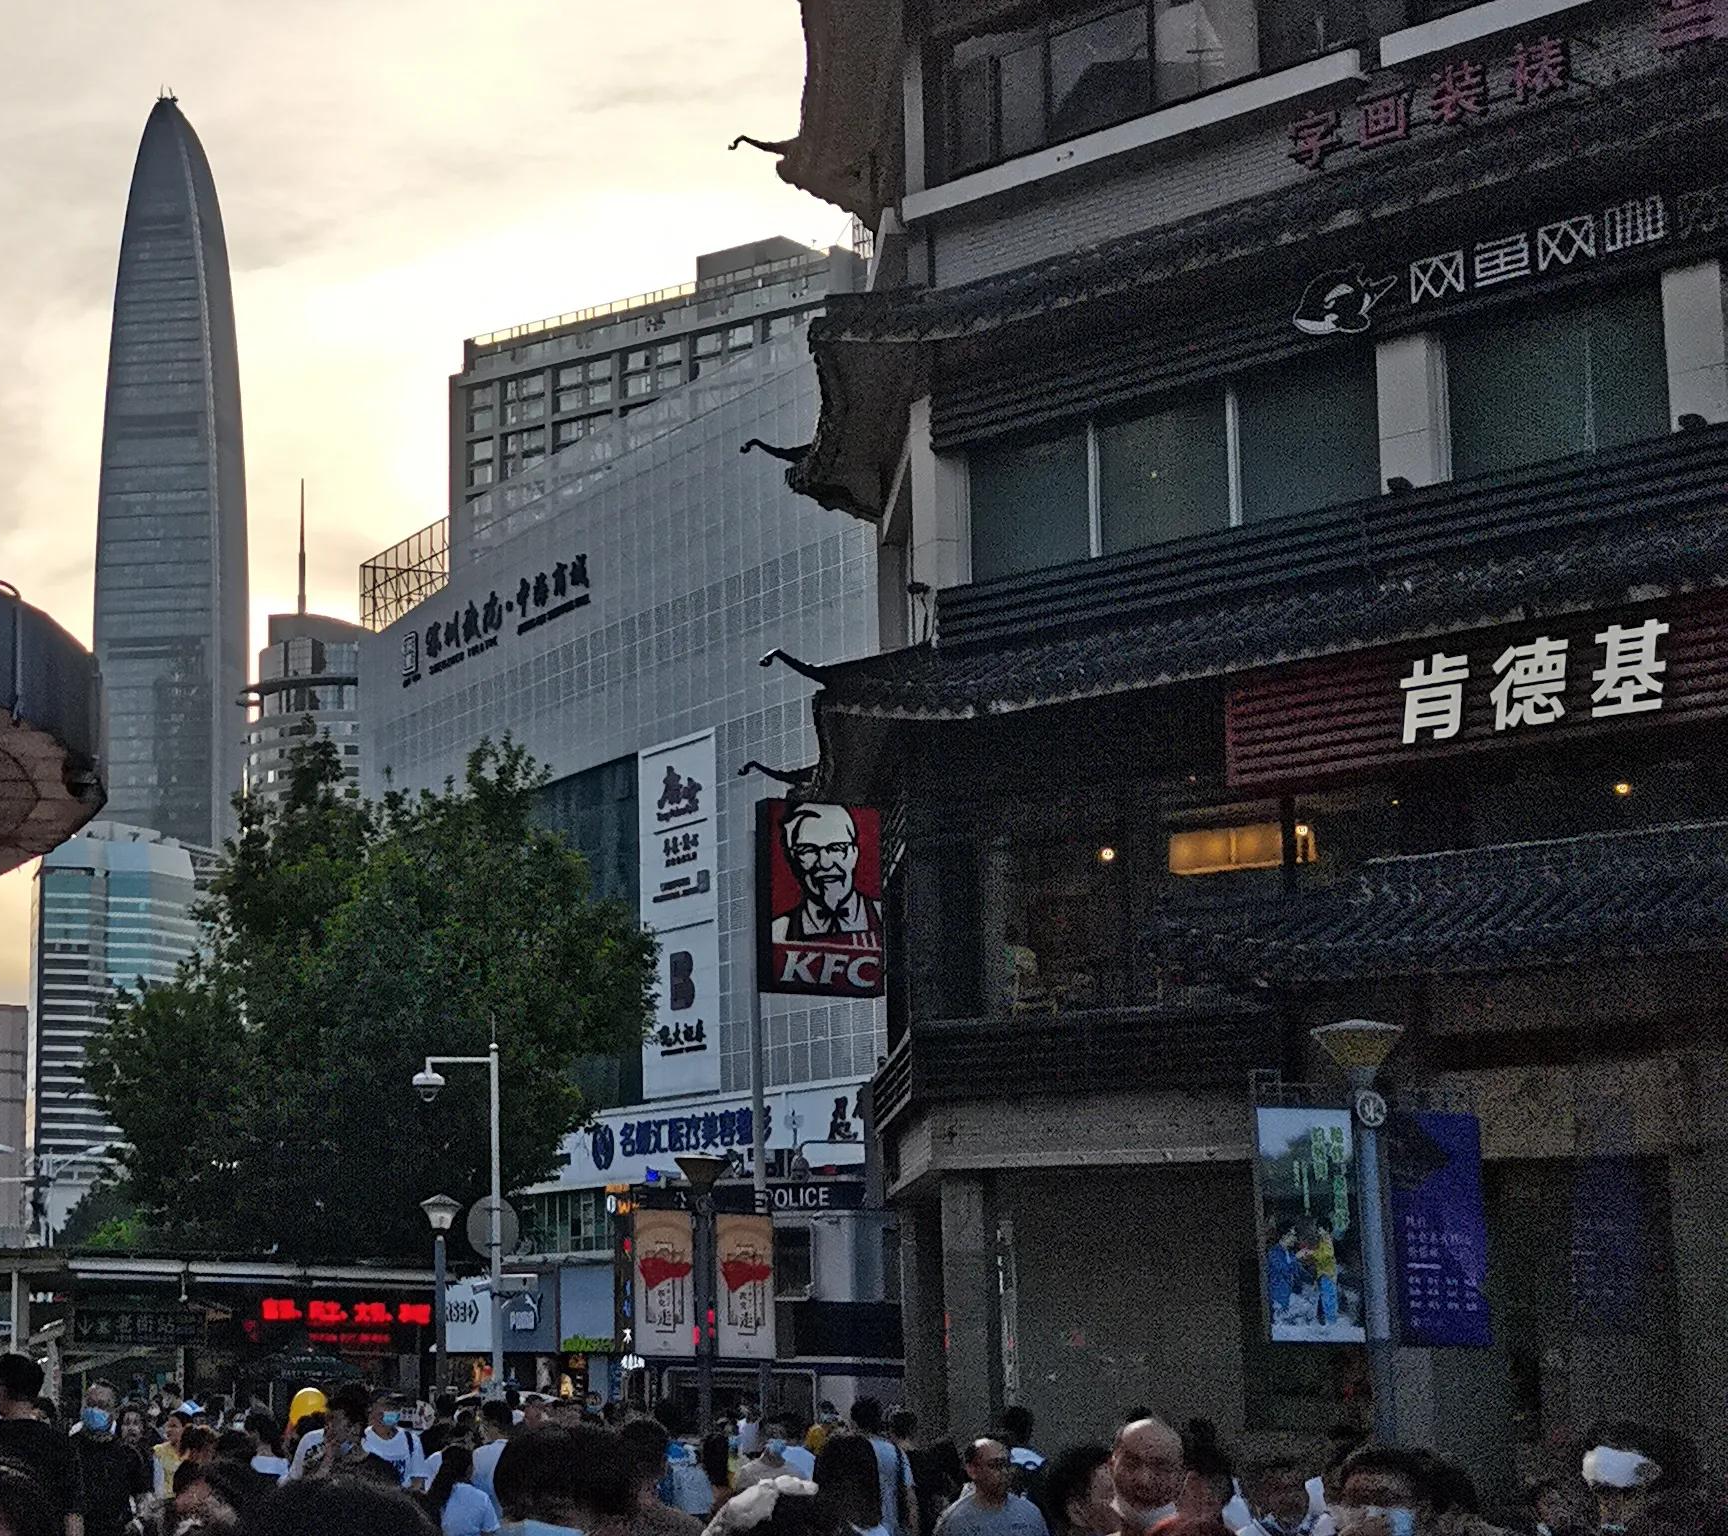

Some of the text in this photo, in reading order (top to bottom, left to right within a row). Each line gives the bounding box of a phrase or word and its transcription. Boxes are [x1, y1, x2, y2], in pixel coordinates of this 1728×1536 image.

[1289, 34, 1574, 171] 字画装裱
[1409, 194, 1666, 306] 网鱼网咖
[1399, 618, 1671, 747] 肯德基
[780, 948, 880, 990] KFC
